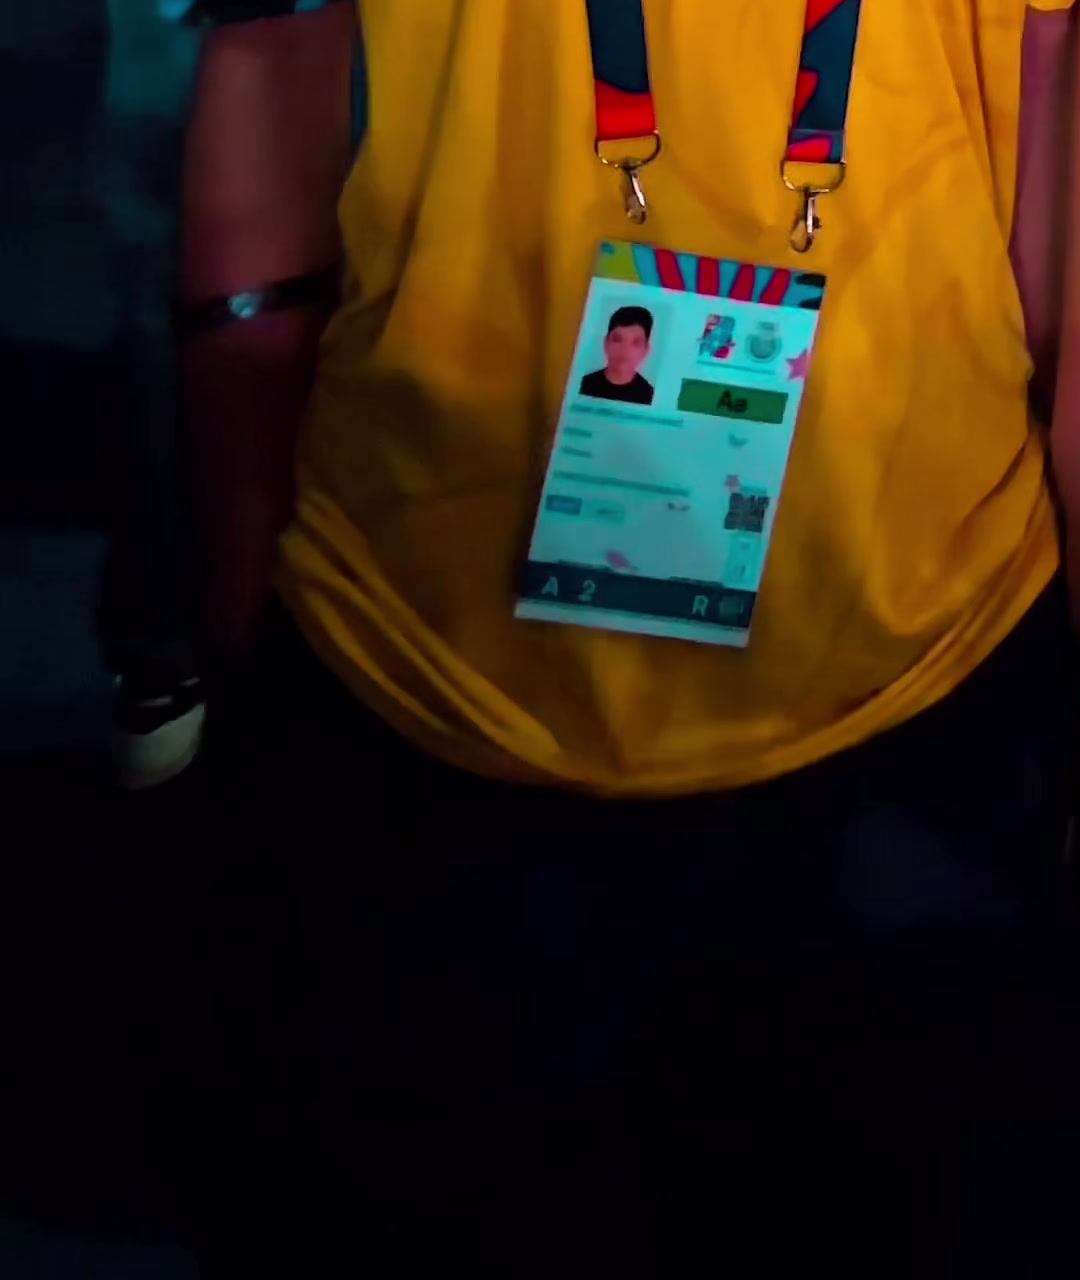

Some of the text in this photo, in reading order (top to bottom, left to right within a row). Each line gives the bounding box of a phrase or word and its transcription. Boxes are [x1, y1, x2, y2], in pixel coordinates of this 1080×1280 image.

[715, 389, 748, 415] Aa
[540, 576, 596, 602] A 2
